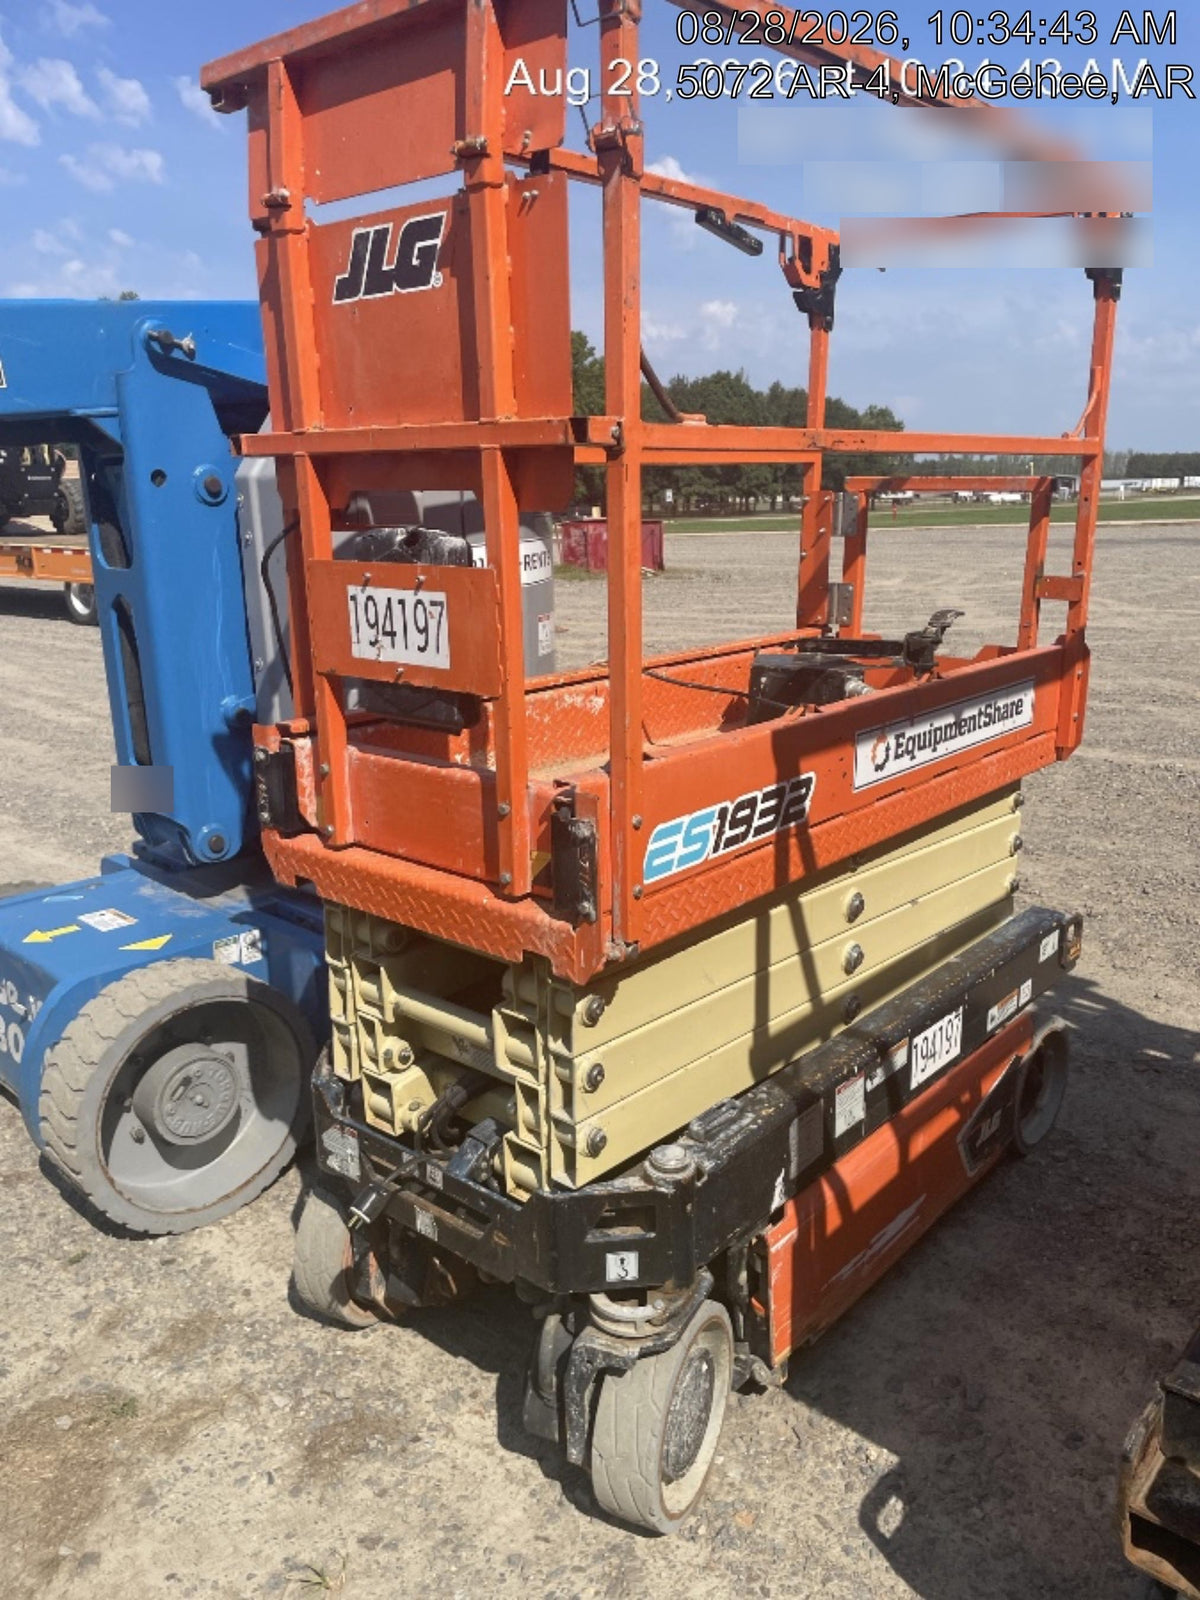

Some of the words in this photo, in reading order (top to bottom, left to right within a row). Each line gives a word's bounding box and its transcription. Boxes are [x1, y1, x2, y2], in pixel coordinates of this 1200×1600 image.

[332, 211, 447, 305] JLG
[349, 593, 445, 655] 194197
[893, 697, 1024, 762] EquipmentShare
[643, 771, 816, 885] ES1932
[913, 1012, 962, 1079] 194197
